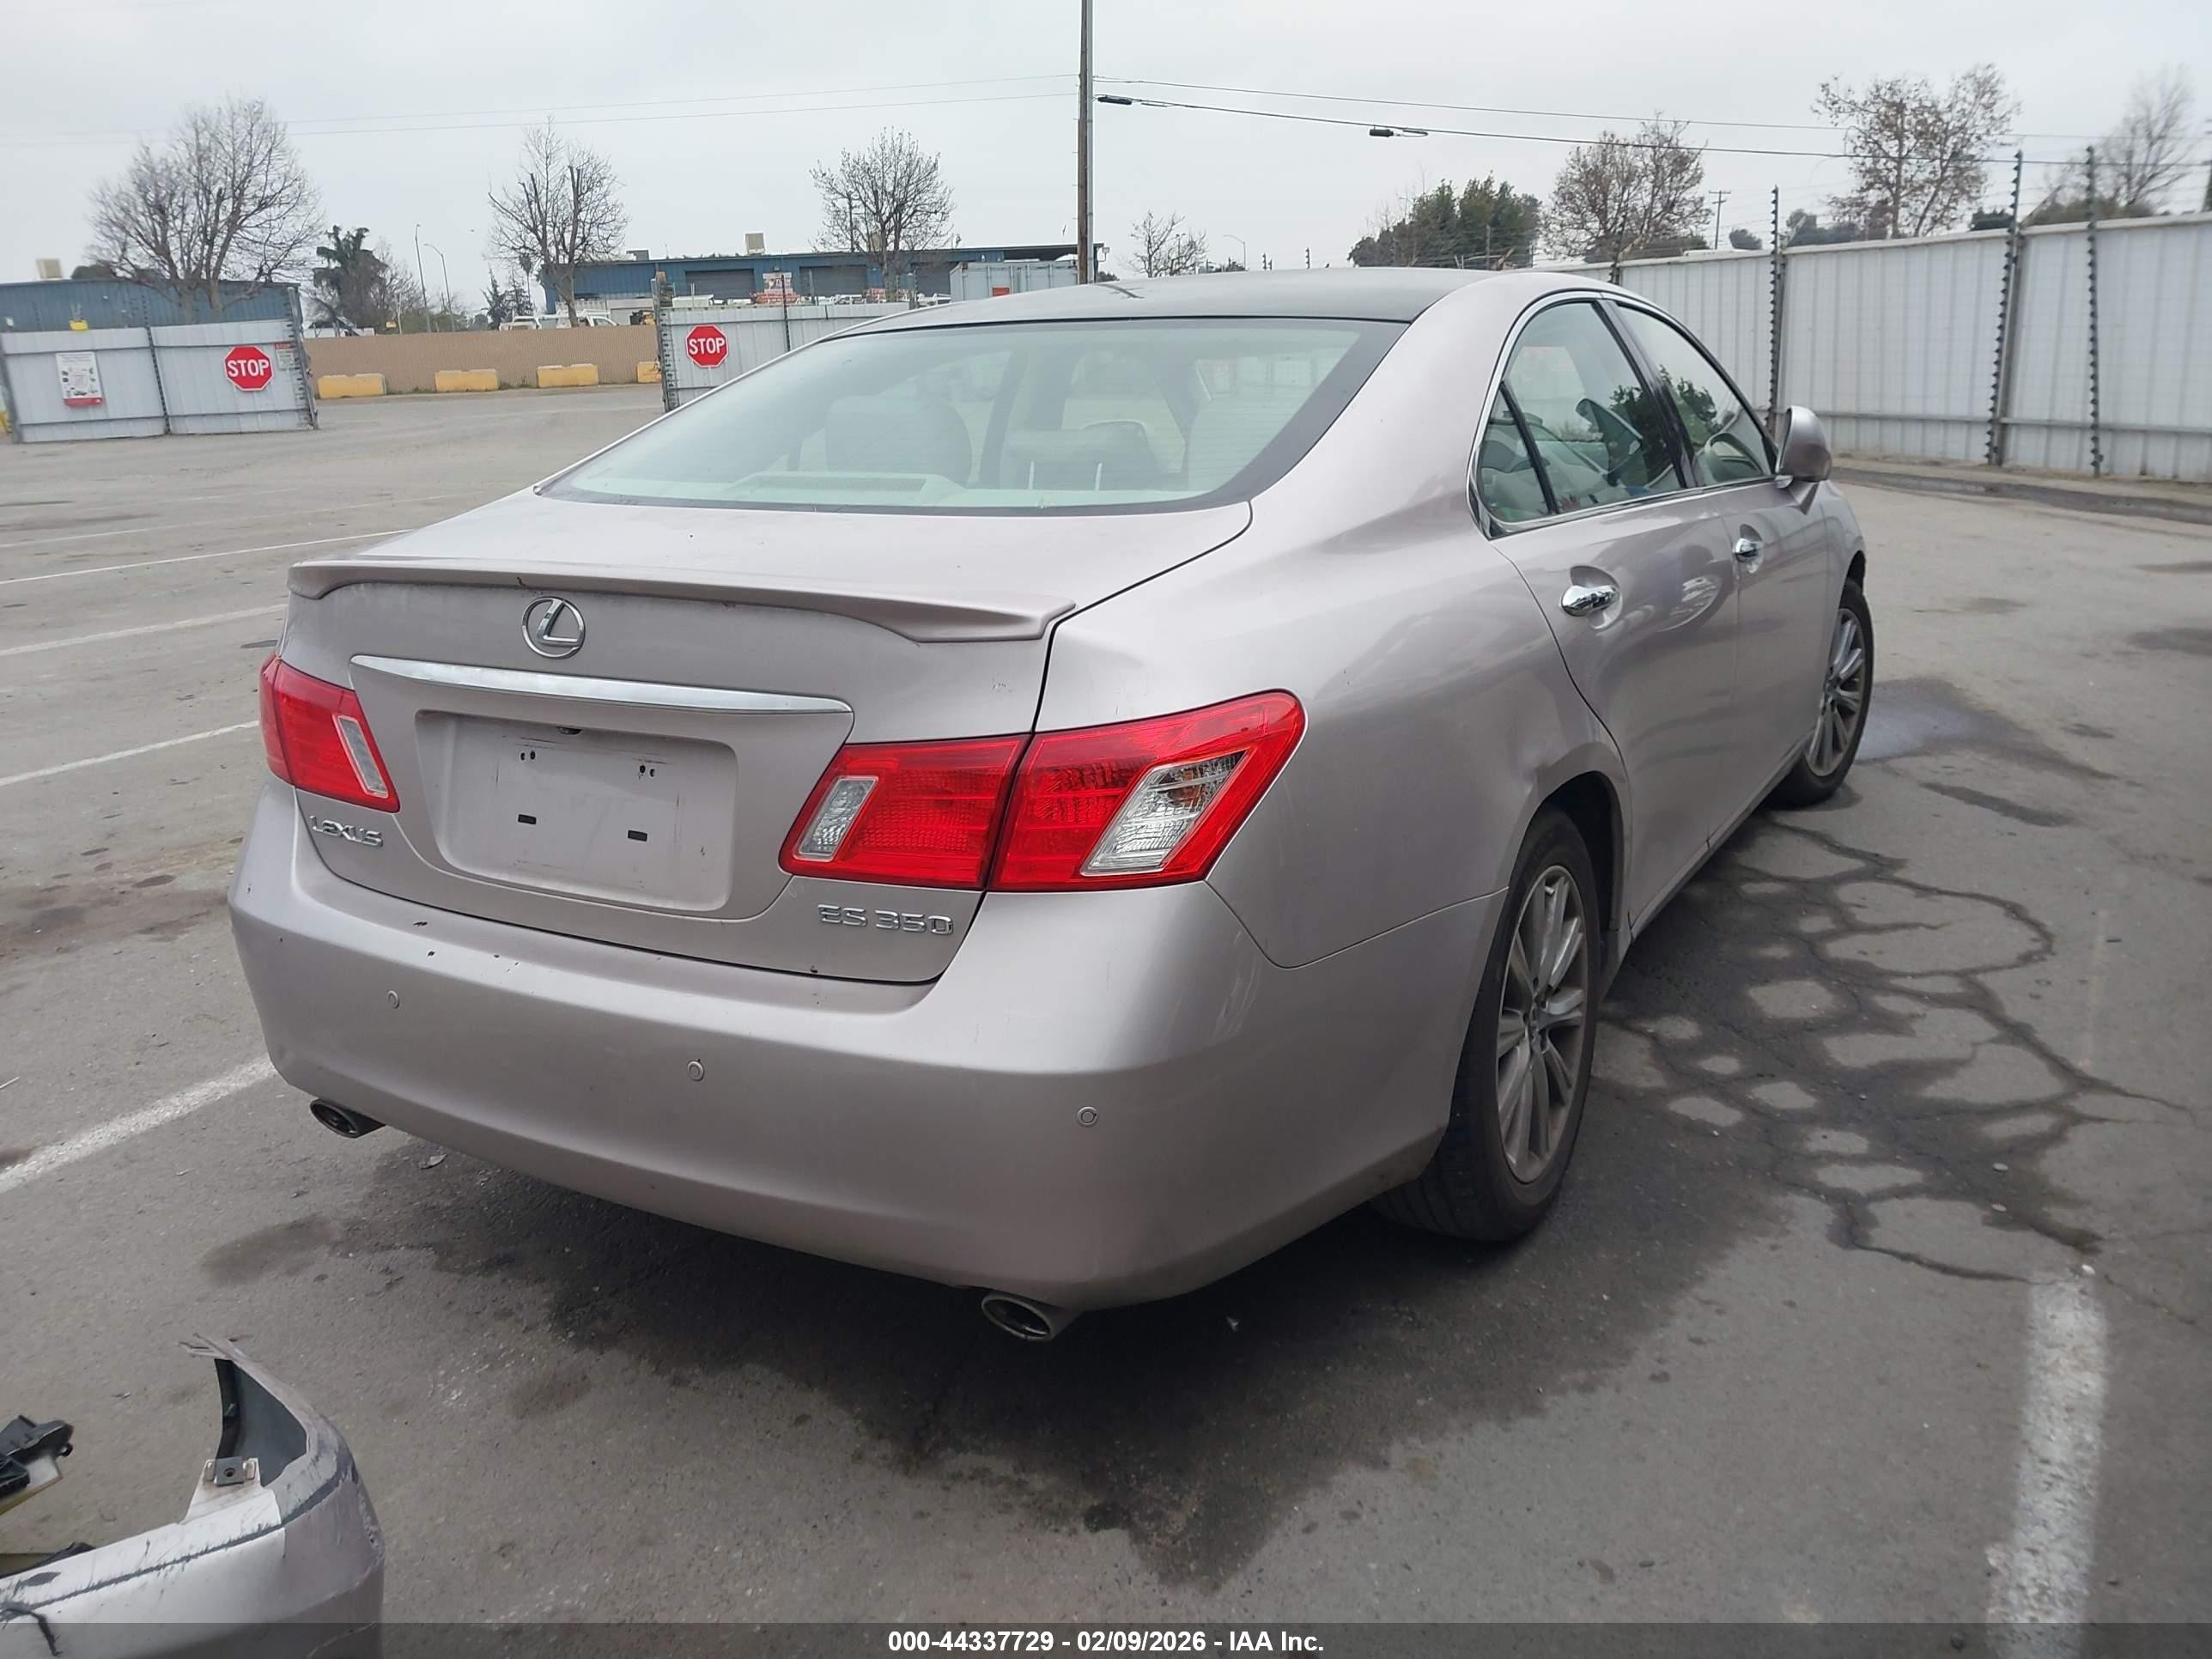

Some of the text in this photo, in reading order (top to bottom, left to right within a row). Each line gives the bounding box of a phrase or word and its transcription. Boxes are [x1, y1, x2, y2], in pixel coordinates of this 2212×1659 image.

[689, 337, 725, 355] STOP
[228, 359, 269, 377] STOP
[309, 816, 383, 847] LEXUS
[817, 903, 953, 935] ES 350
